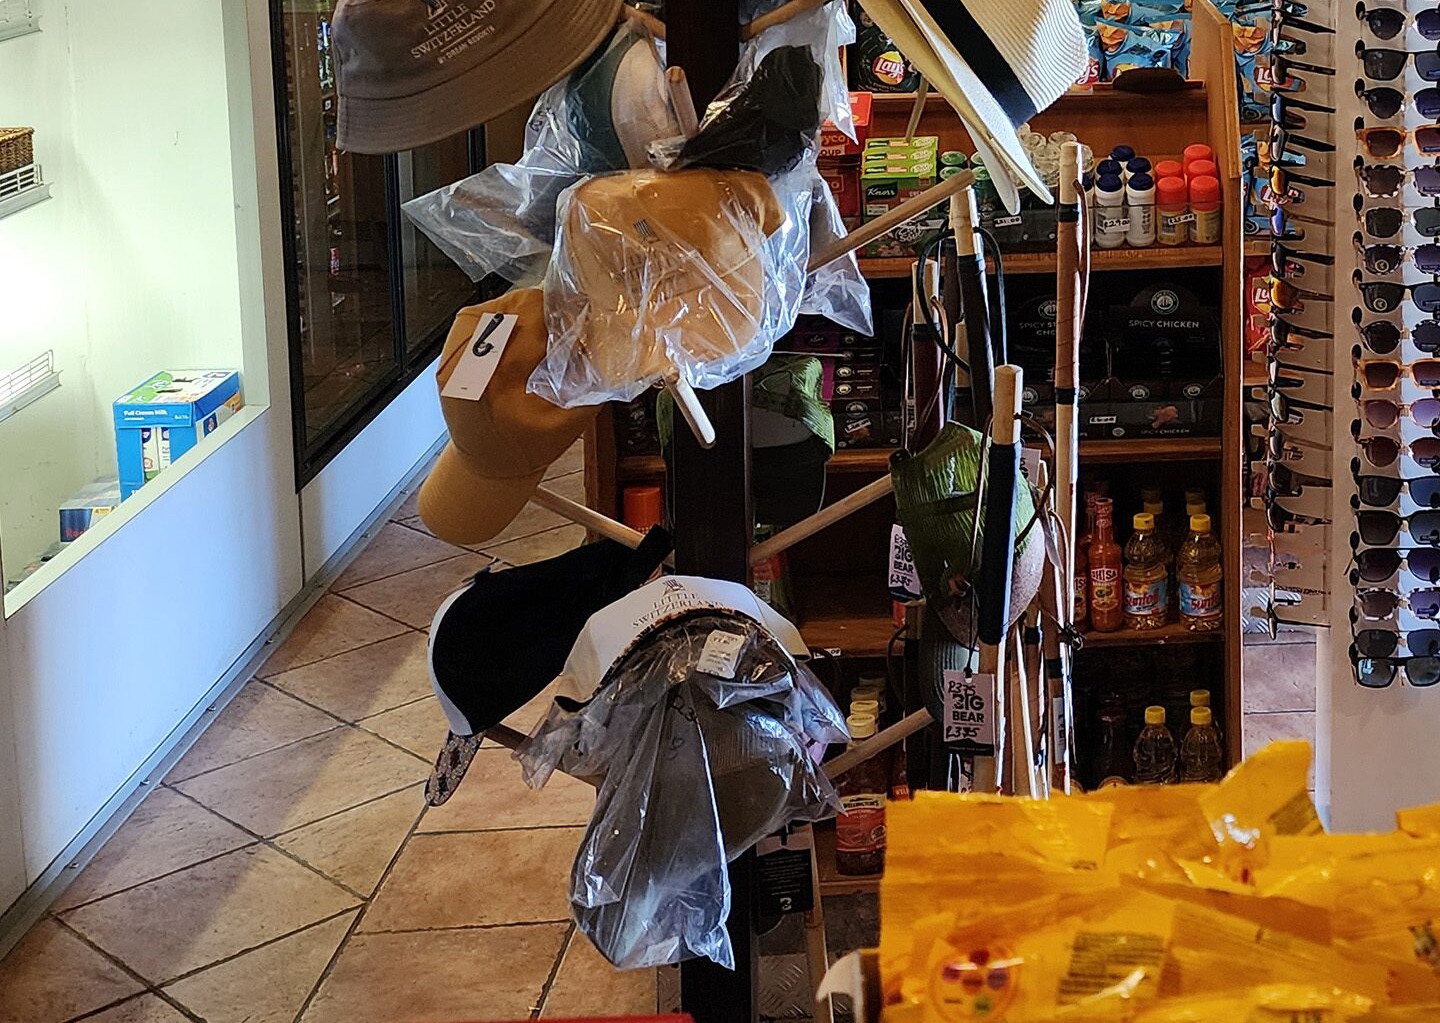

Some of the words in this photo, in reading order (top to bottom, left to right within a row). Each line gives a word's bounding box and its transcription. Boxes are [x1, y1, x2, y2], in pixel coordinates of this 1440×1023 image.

[424, 3, 470, 35] LITTLE
[411, 0, 495, 58] SWITZERLAND
[868, 186, 896, 197] Knorr
[1129, 319, 1154, 328] SPICY
[1157, 320, 1200, 328] CHICKEN
[894, 561, 914, 575] BEAR
[952, 693, 985, 711] BIG
[952, 710, 985, 724] BEAR
